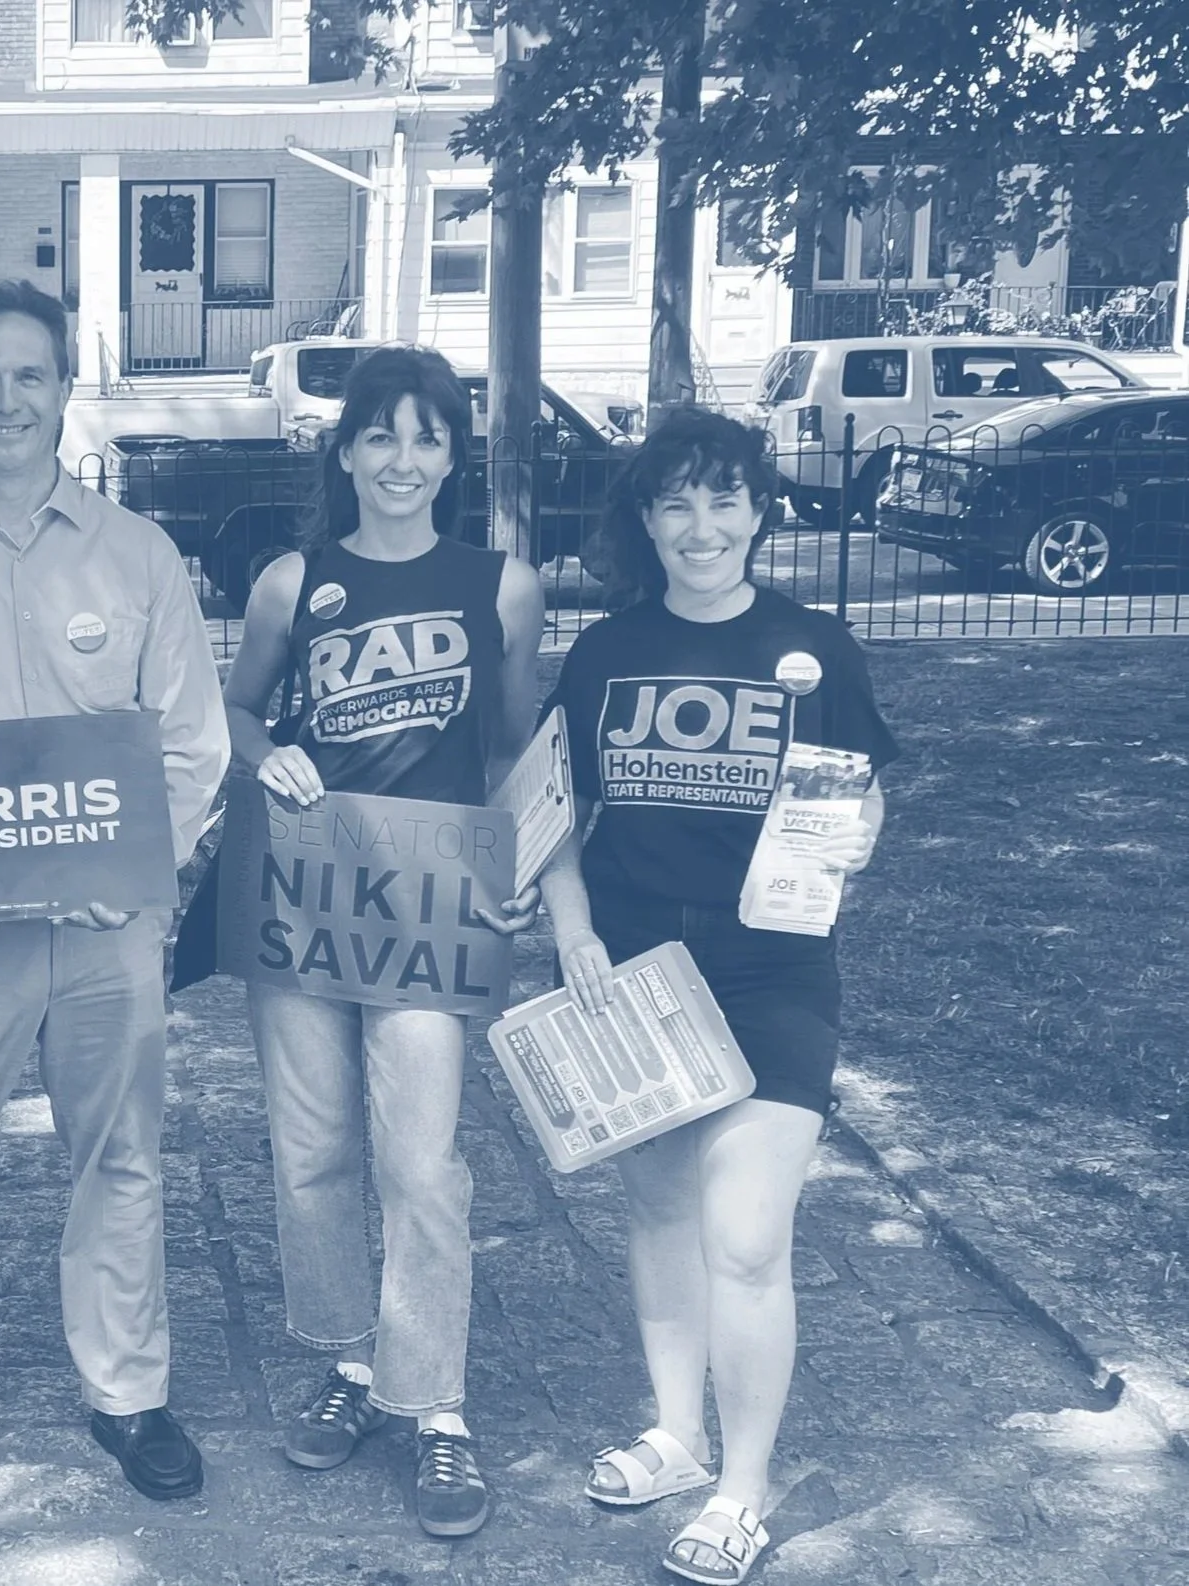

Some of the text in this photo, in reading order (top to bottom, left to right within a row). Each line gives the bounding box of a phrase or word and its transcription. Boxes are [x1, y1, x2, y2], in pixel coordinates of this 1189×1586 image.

[309, 619, 469, 700] RAD
[318, 680, 456, 719] RIVERWARDS AREA
[324, 695, 455, 733] DEMOCRATS
[607, 685, 785, 754] JOE
[607, 783, 769, 806] STATE REPRESENTATIVE
[608, 753, 769, 787] Hohenstein
[267, 802, 498, 863] SENATOR
[260, 851, 483, 929] NIKIL
[767, 878, 798, 891] JOE
[258, 918, 490, 998] SAVAL
